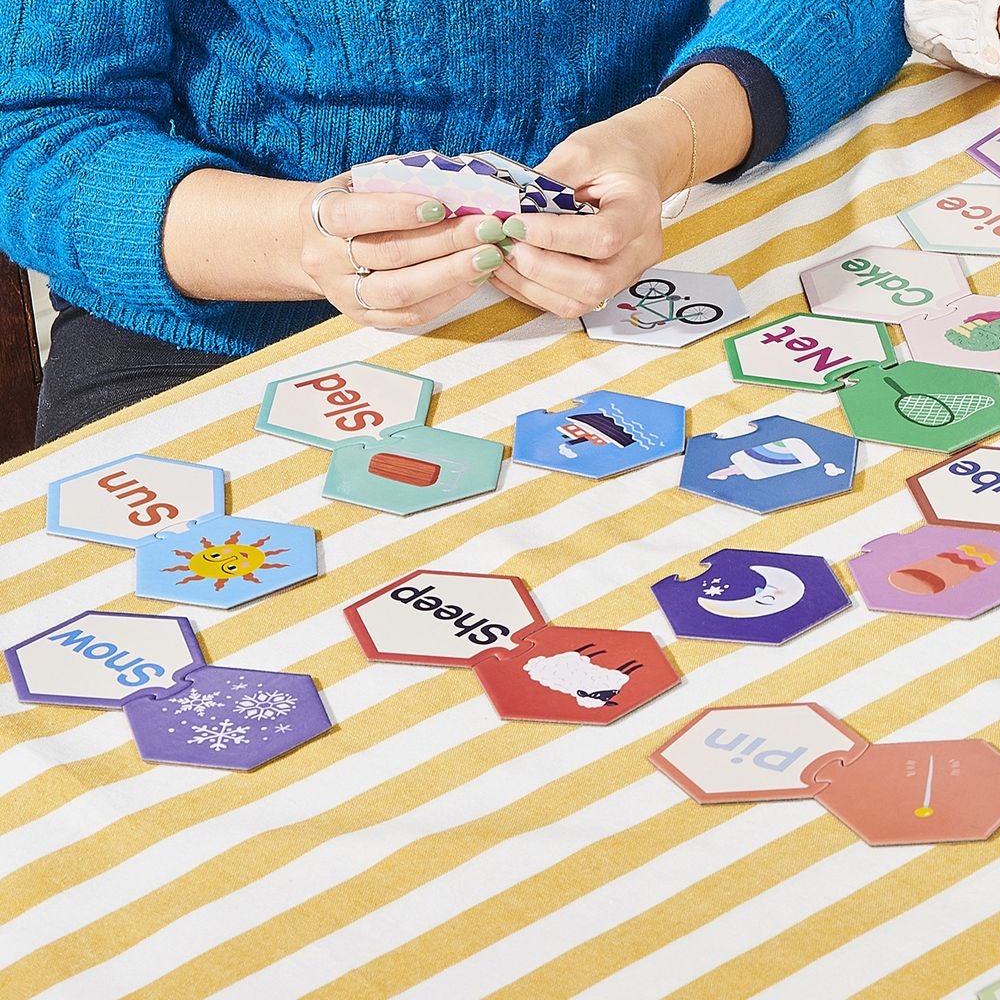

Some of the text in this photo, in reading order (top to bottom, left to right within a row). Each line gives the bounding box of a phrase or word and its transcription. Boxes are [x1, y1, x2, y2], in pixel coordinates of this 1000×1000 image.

[841, 258, 934, 307] Cake
[760, 326, 853, 372] Net
[294, 373, 384, 431] Sled
[98, 471, 179, 526] Sun
[390, 586, 510, 645] Sheep
[47, 629, 165, 687] Snow
[704, 728, 808, 772] Pin
